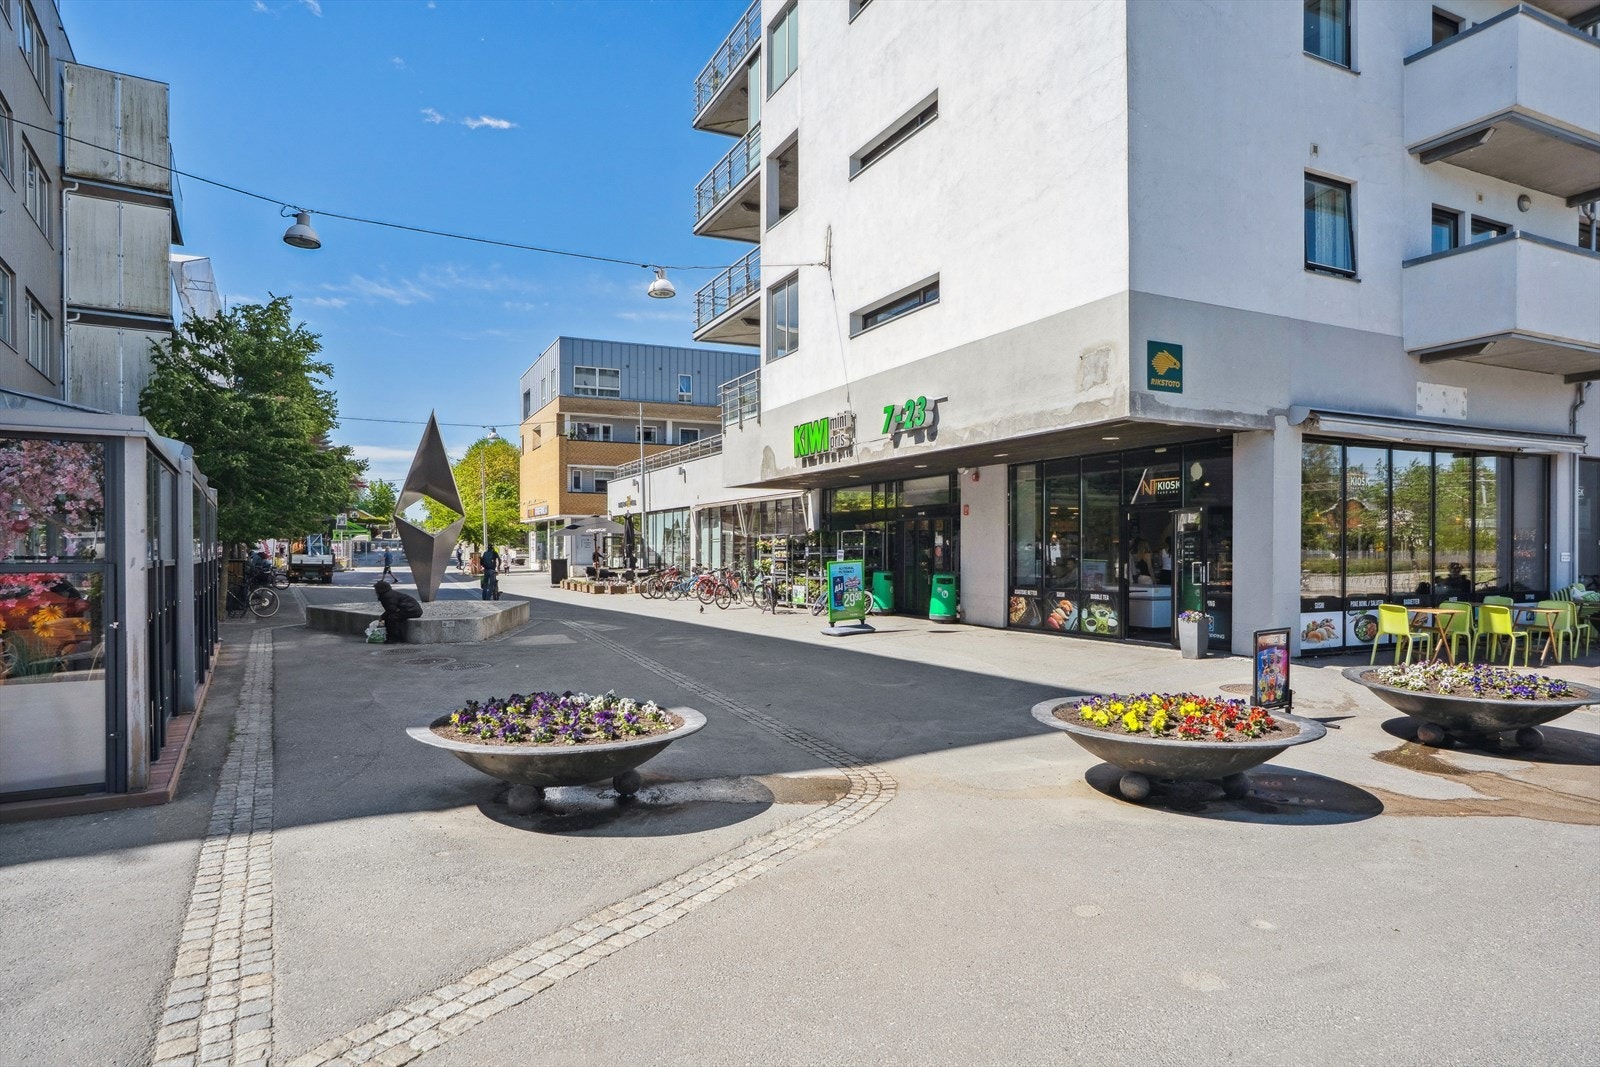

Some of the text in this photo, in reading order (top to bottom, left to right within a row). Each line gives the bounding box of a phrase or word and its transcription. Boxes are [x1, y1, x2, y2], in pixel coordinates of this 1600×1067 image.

[1151, 378, 1181, 388] RIKSTOTO
[829, 410, 847, 430] mini
[882, 396, 927, 434] 7-23
[793, 416, 829, 459] KIWI
[829, 434, 845, 451] pris
[1157, 480, 1180, 490] KIOSK
